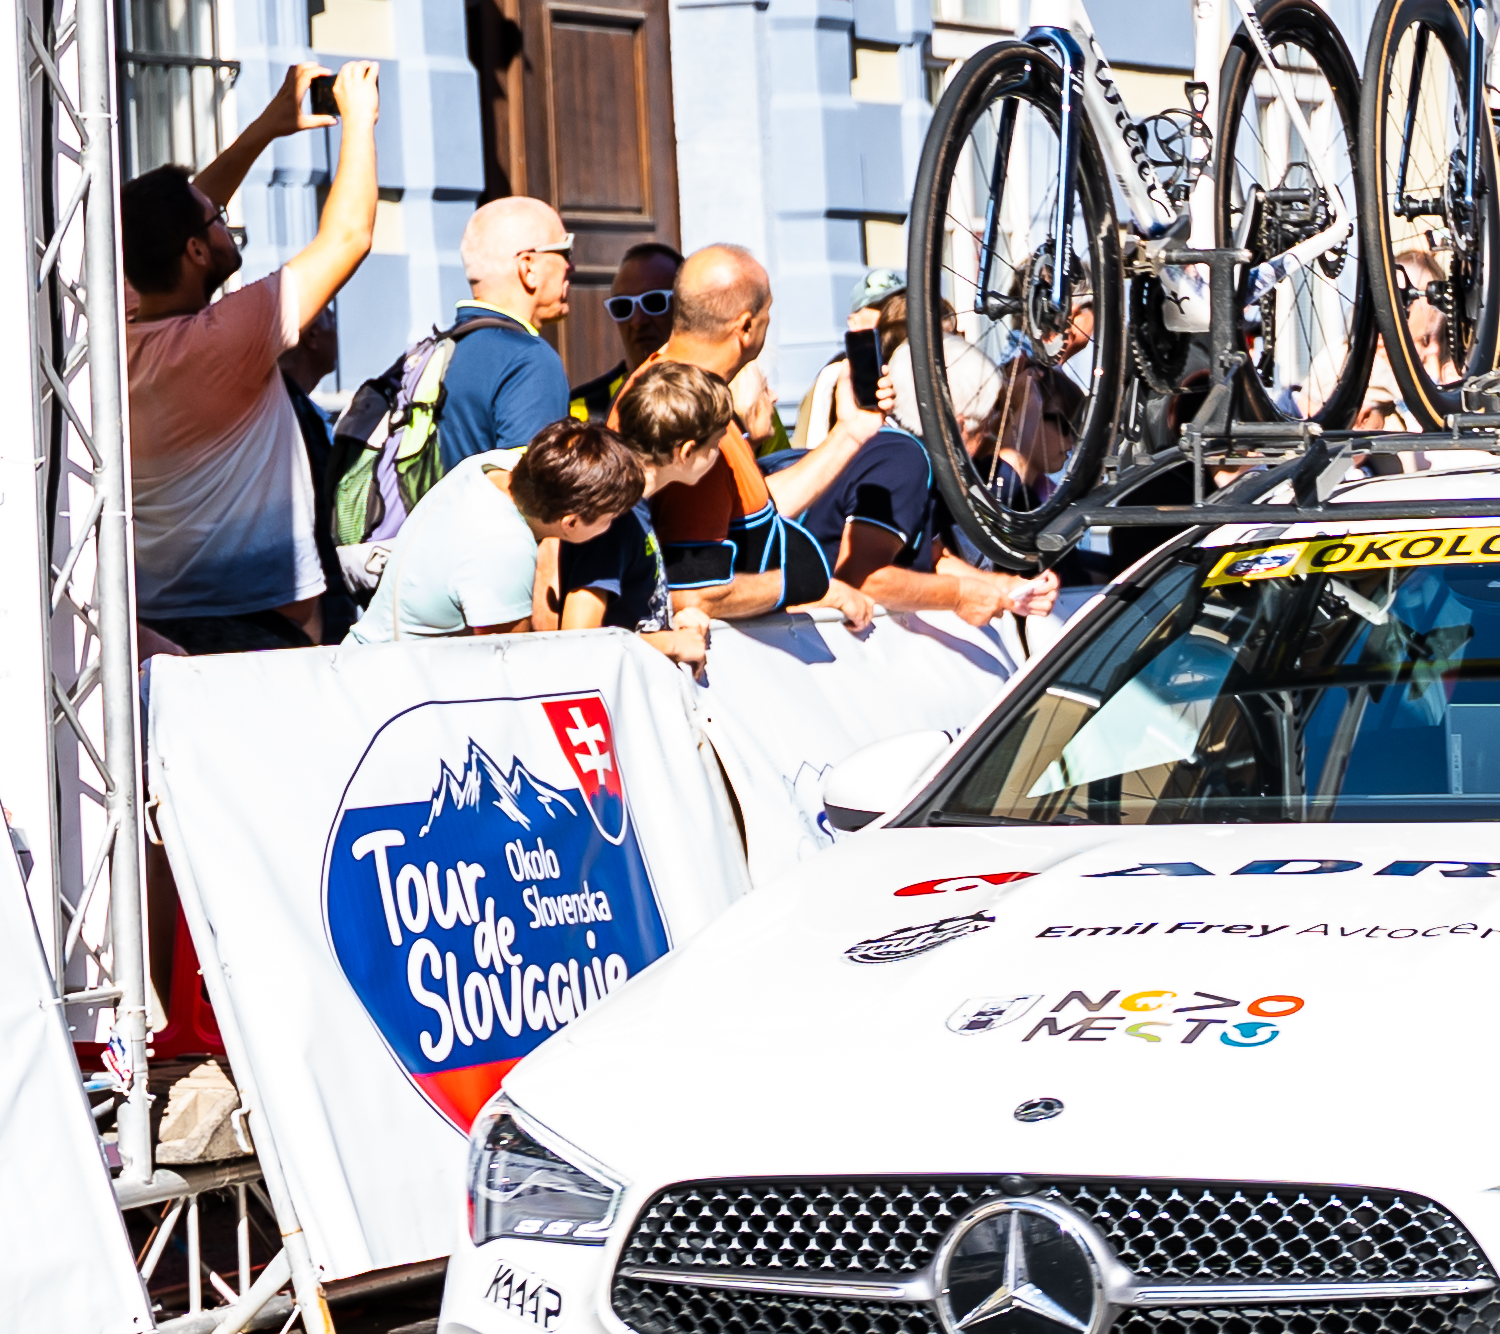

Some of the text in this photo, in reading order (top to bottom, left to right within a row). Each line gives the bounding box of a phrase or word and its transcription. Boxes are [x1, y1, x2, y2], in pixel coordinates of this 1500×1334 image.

[504, 837, 561, 884] Okolo
[351, 829, 487, 948] Tour
[521, 880, 613, 931] Slovenska
[474, 898, 520, 972] de
[1034, 921, 1160, 939] Emil
[1164, 921, 1291, 938] Frey
